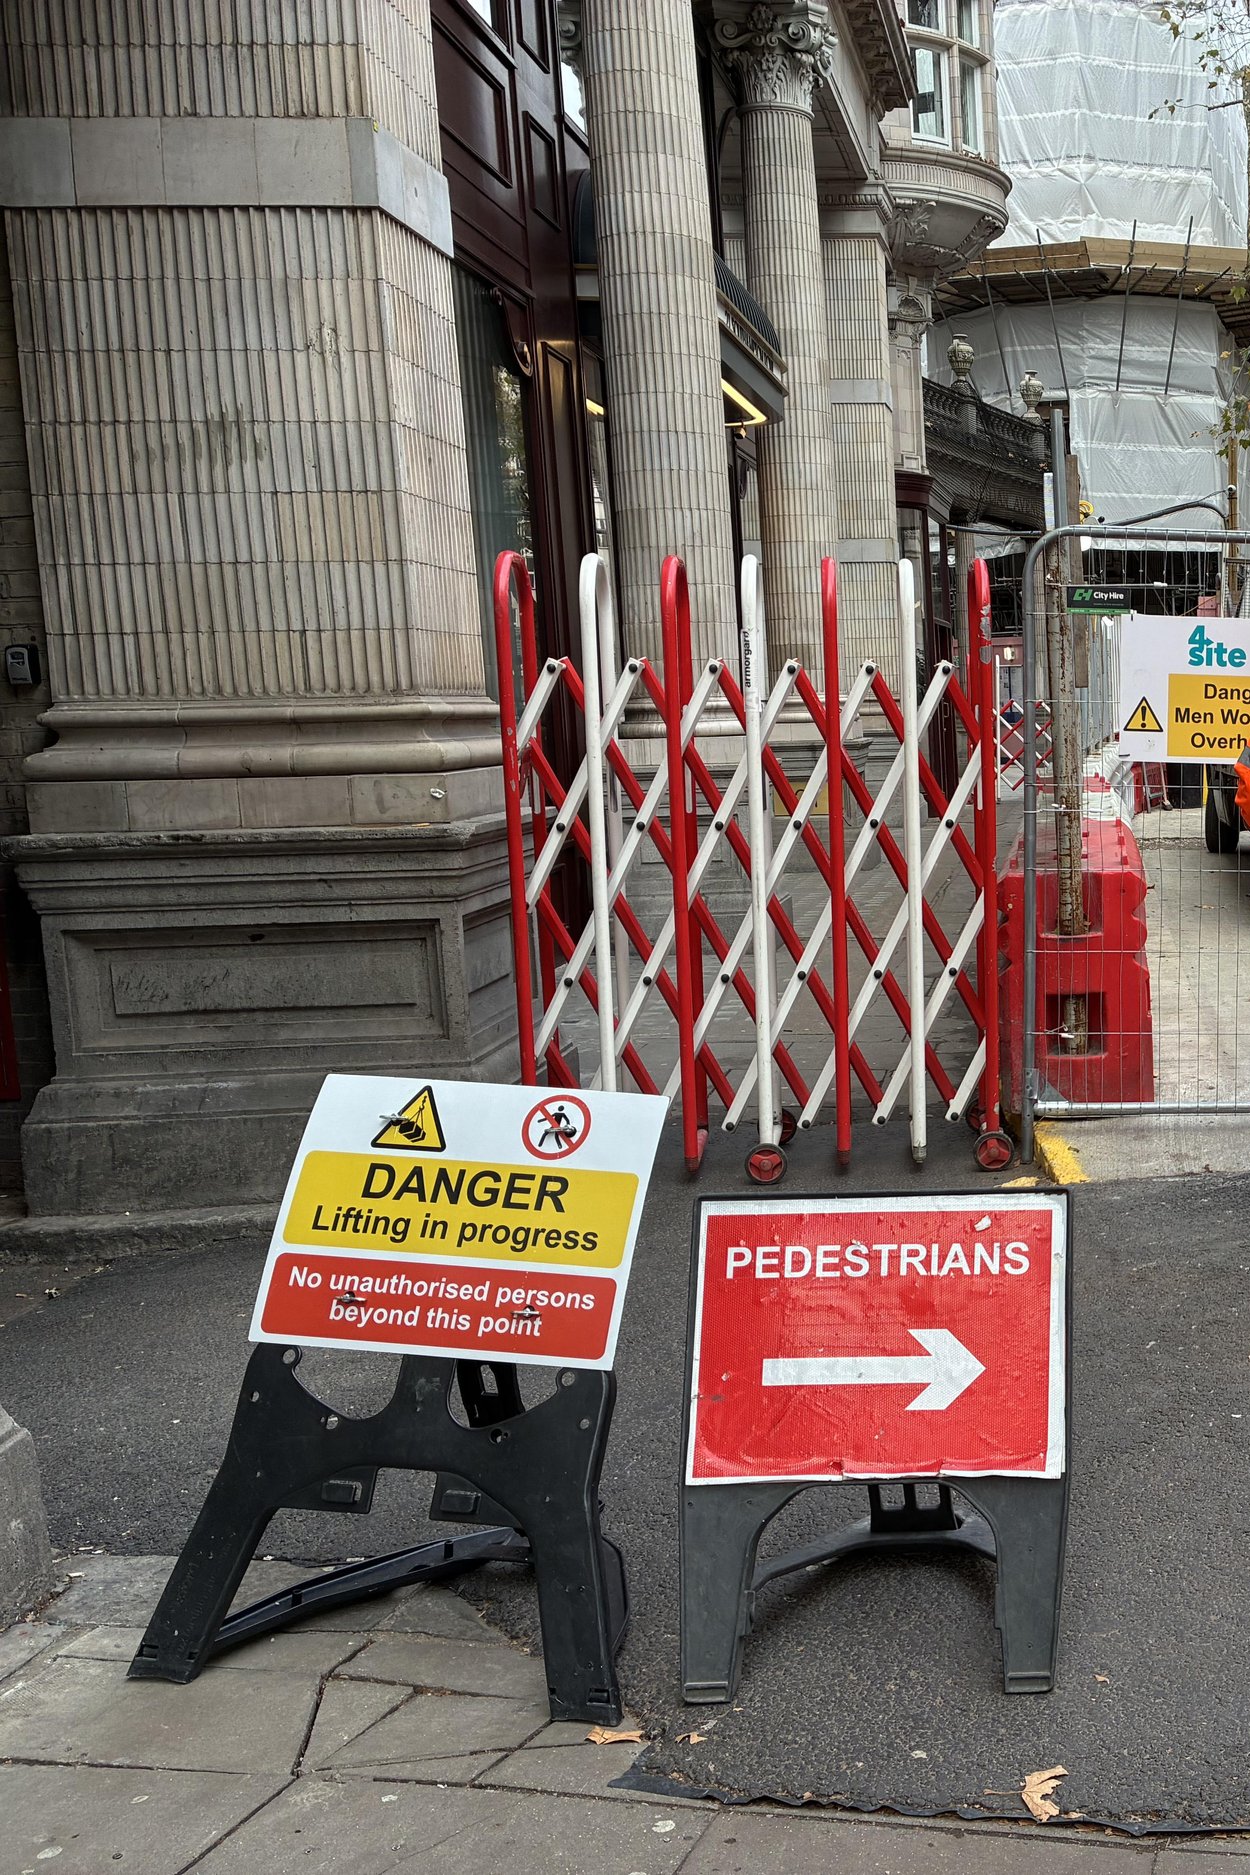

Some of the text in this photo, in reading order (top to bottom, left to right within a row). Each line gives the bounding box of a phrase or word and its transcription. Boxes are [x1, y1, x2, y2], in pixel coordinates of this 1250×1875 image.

[1094, 592, 1108, 600] City
[1175, 707, 1214, 724] Men
[361, 1162, 570, 1213] DANGER
[311, 1204, 599, 1252] Lifting in progress
[726, 1241, 1030, 1280] PEDESTRIANS
[288, 1266, 596, 1310] No unauthorised persons
[328, 1300, 542, 1337] beyond this point
